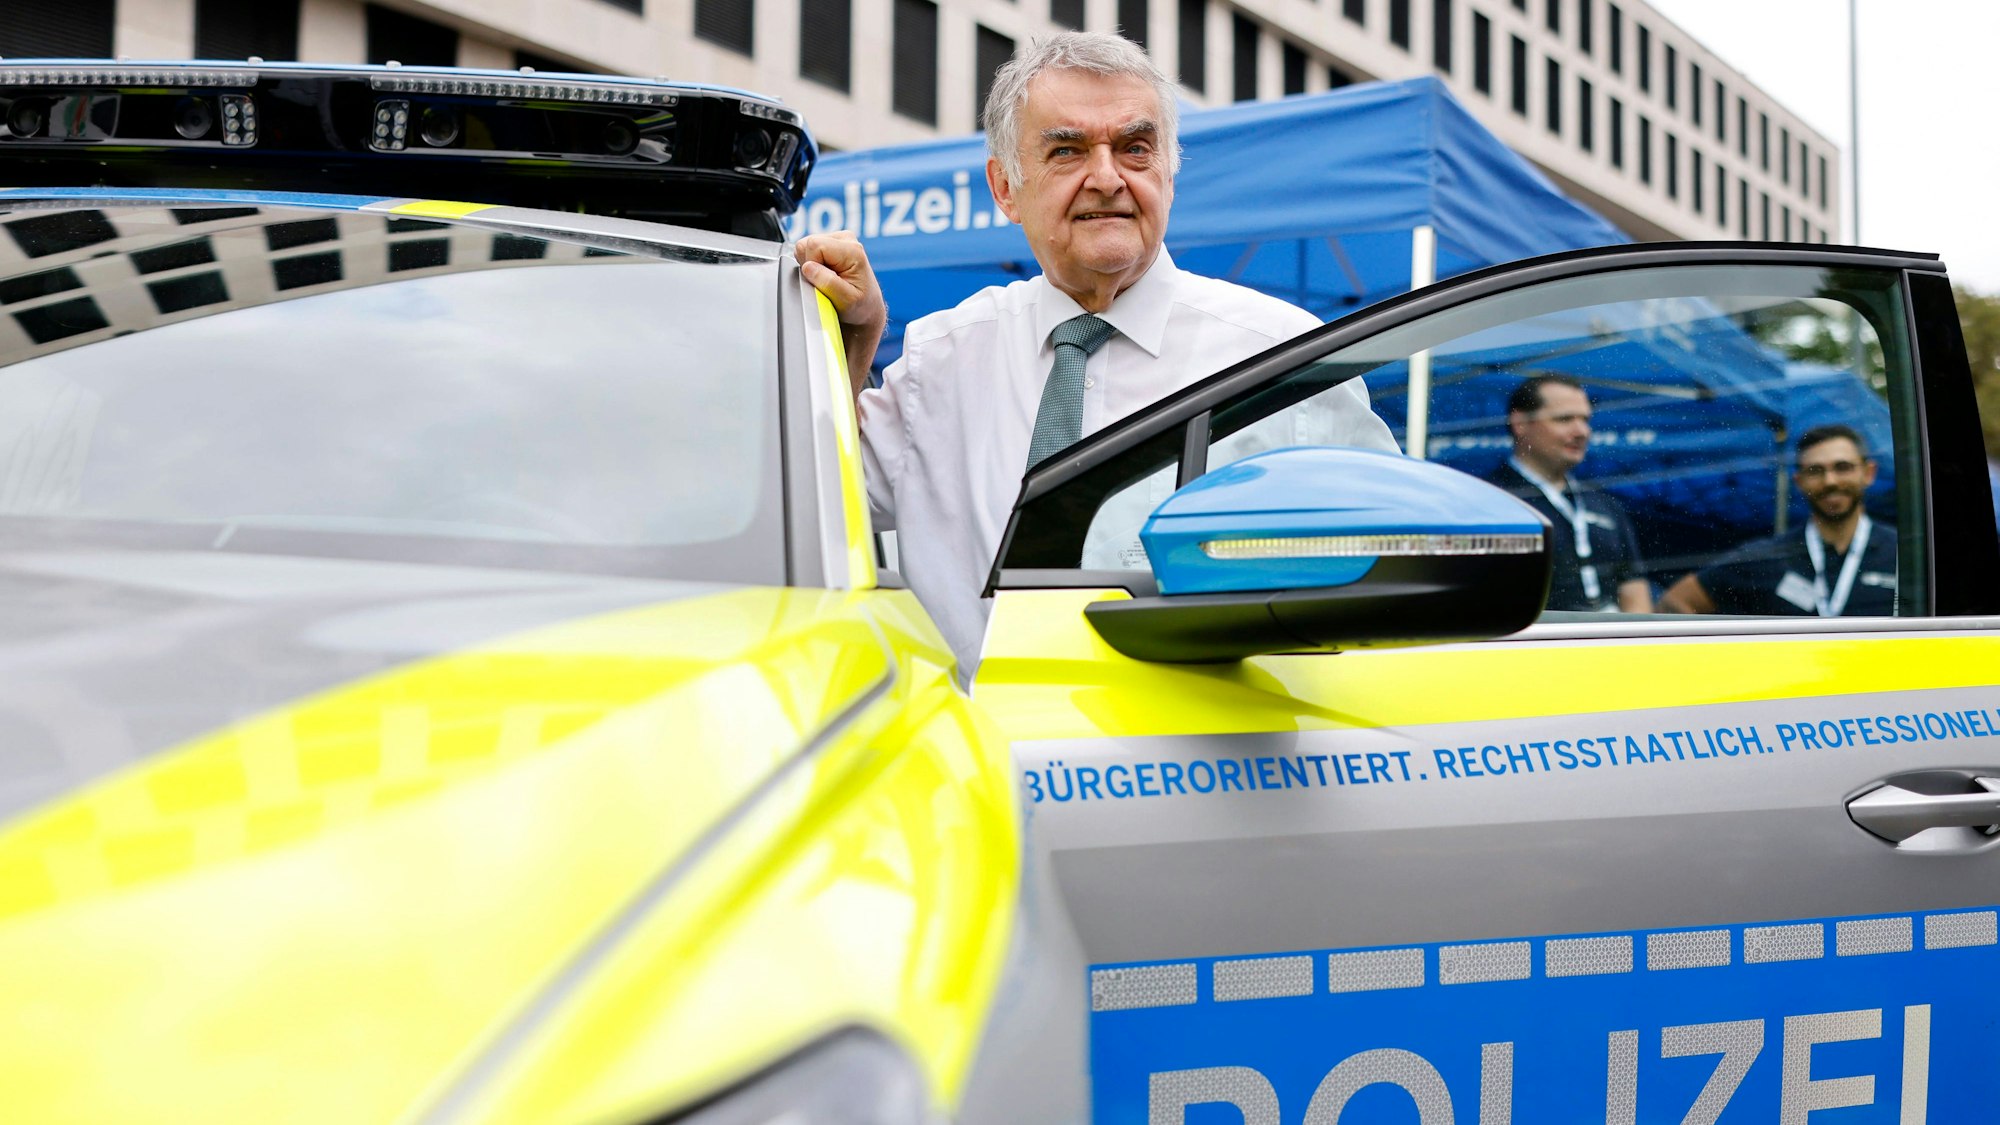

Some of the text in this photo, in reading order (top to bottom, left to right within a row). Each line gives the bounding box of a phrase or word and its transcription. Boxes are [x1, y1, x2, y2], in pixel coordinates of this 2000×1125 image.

[784, 170, 1010, 240] olizei.
[1024, 708, 2000, 803] BÜRGERORIENTIERT. RECHTSSTAATLICH. PROFESSIONEL
